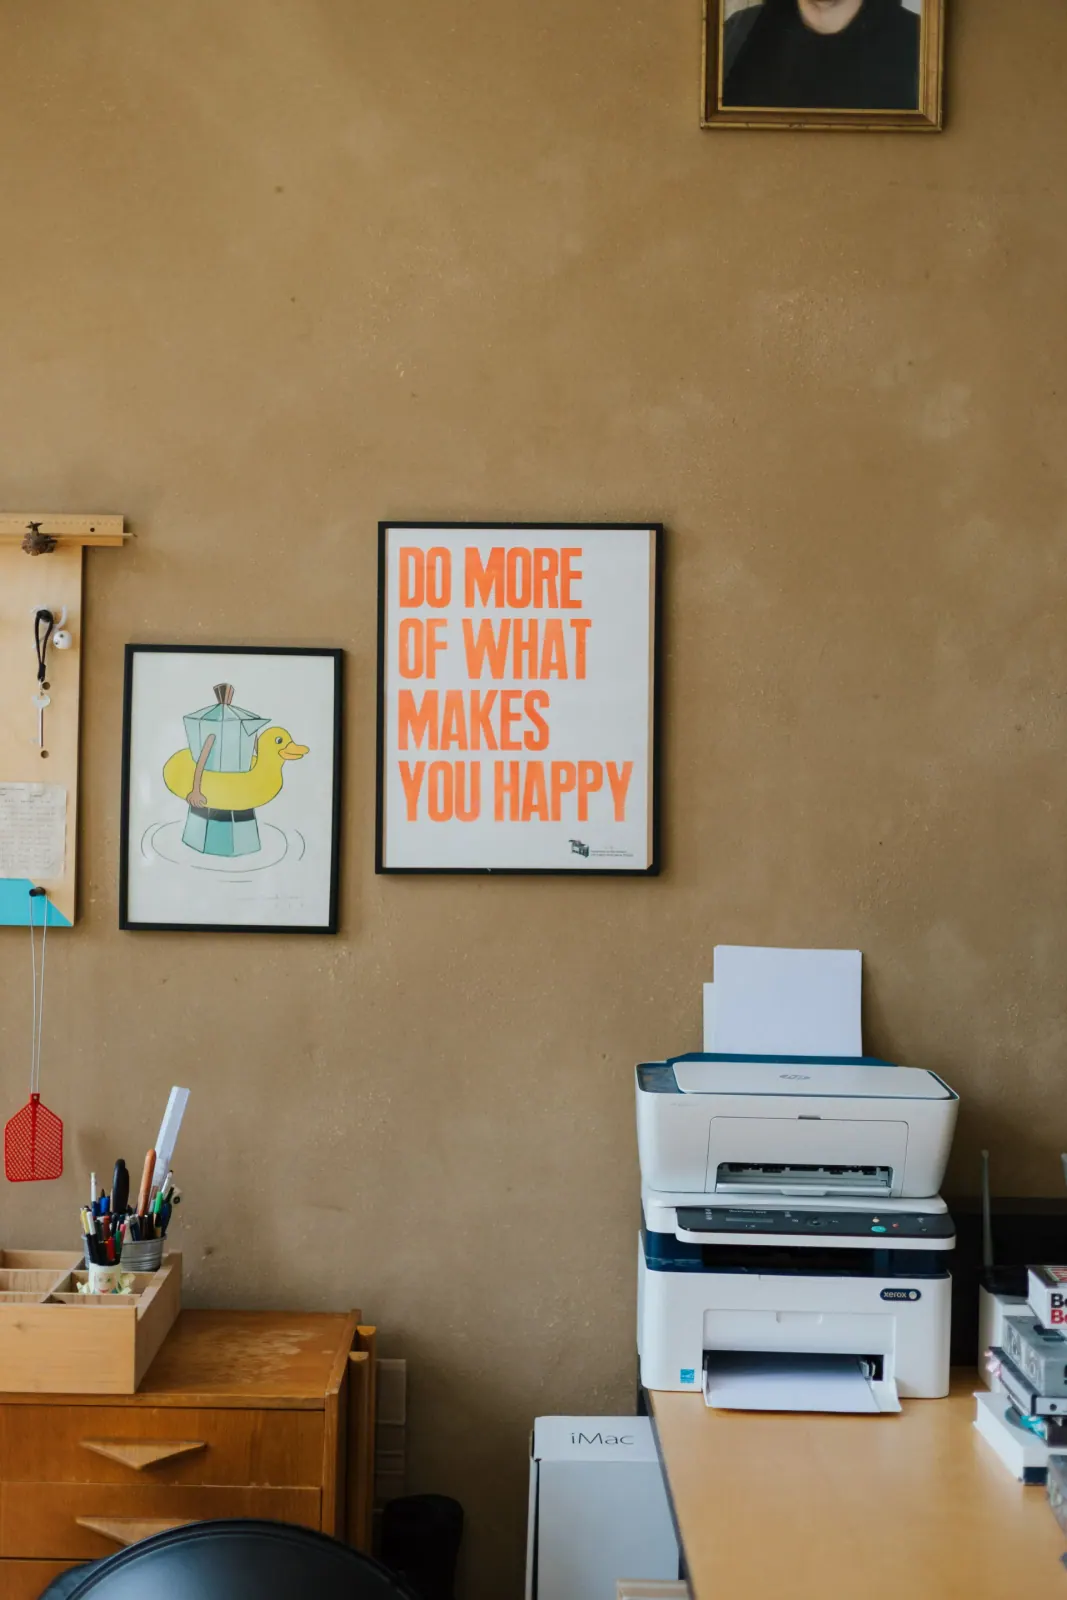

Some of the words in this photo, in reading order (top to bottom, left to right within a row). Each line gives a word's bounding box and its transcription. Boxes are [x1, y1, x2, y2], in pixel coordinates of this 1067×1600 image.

[399, 546, 452, 609] DO
[464, 546, 583, 609] MORE
[398, 617, 448, 680] OF
[462, 618, 592, 680] WHAT
[398, 689, 550, 751] MAKES
[398, 760, 481, 823] YOU
[494, 760, 634, 823] HAPPY
[571, 1432, 634, 1444] iMac
